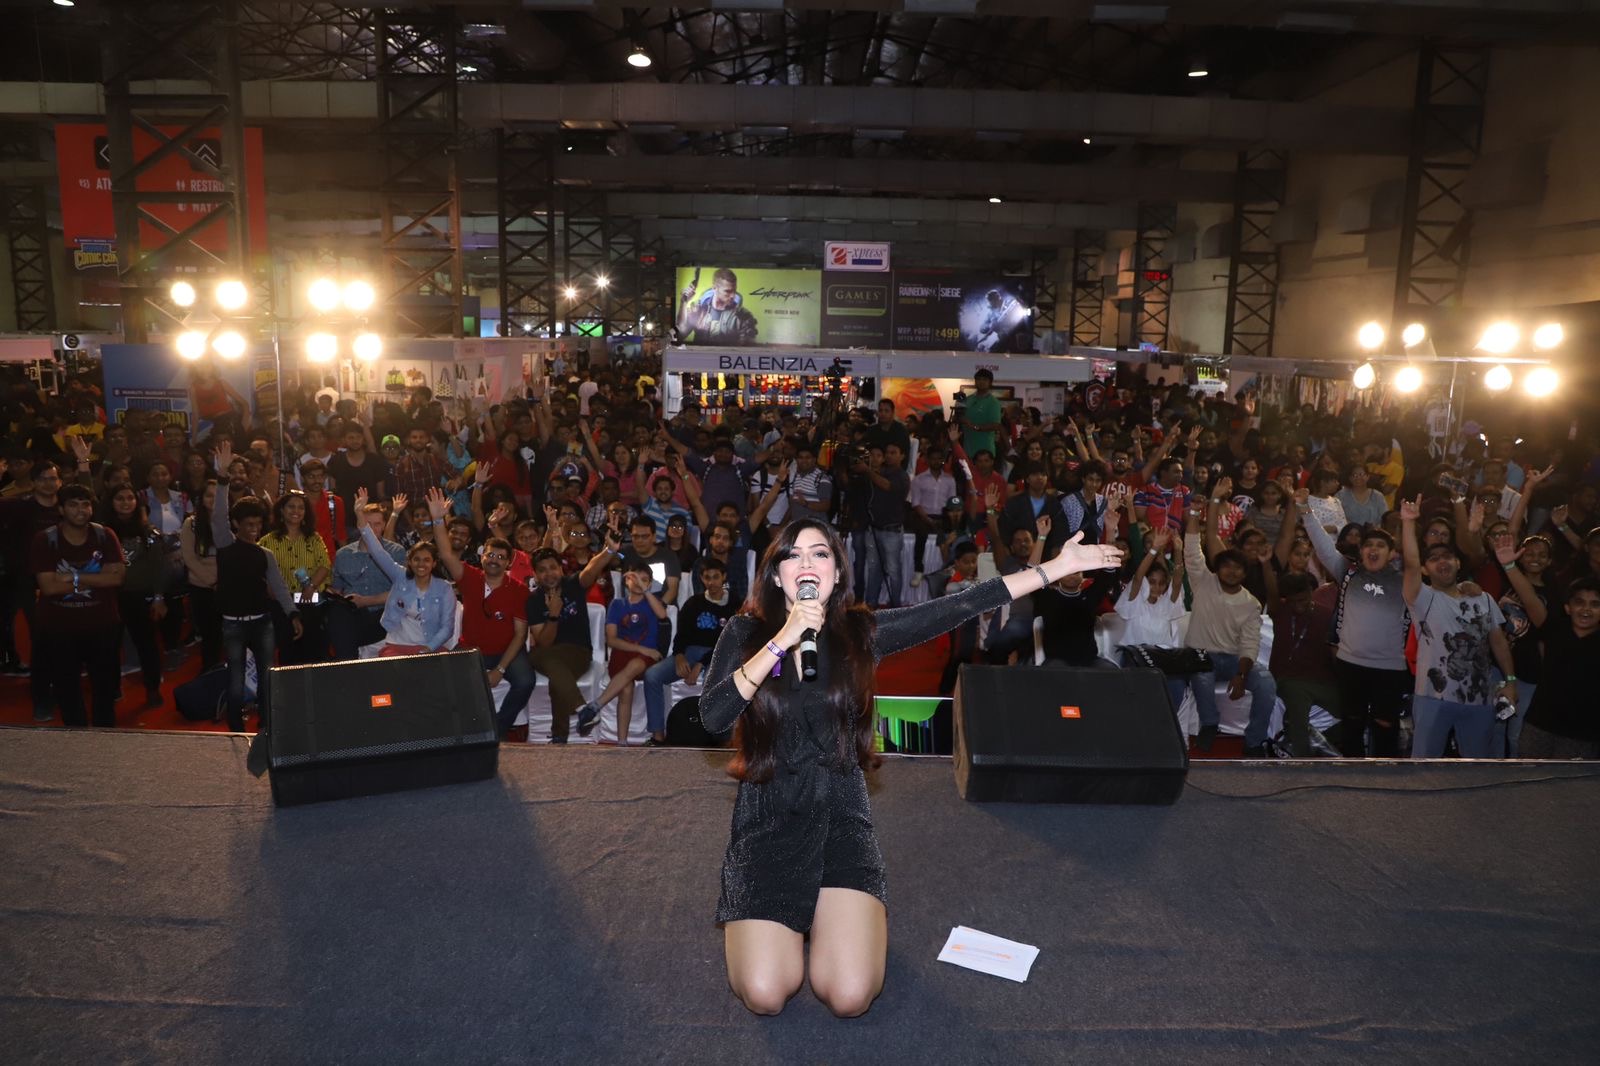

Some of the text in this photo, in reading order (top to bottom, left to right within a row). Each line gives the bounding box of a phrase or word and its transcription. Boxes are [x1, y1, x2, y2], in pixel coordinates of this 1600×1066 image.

[835, 289, 881, 301] GAMES
[940, 287, 961, 298] SIEGE
[719, 355, 817, 371] BALENZIA
